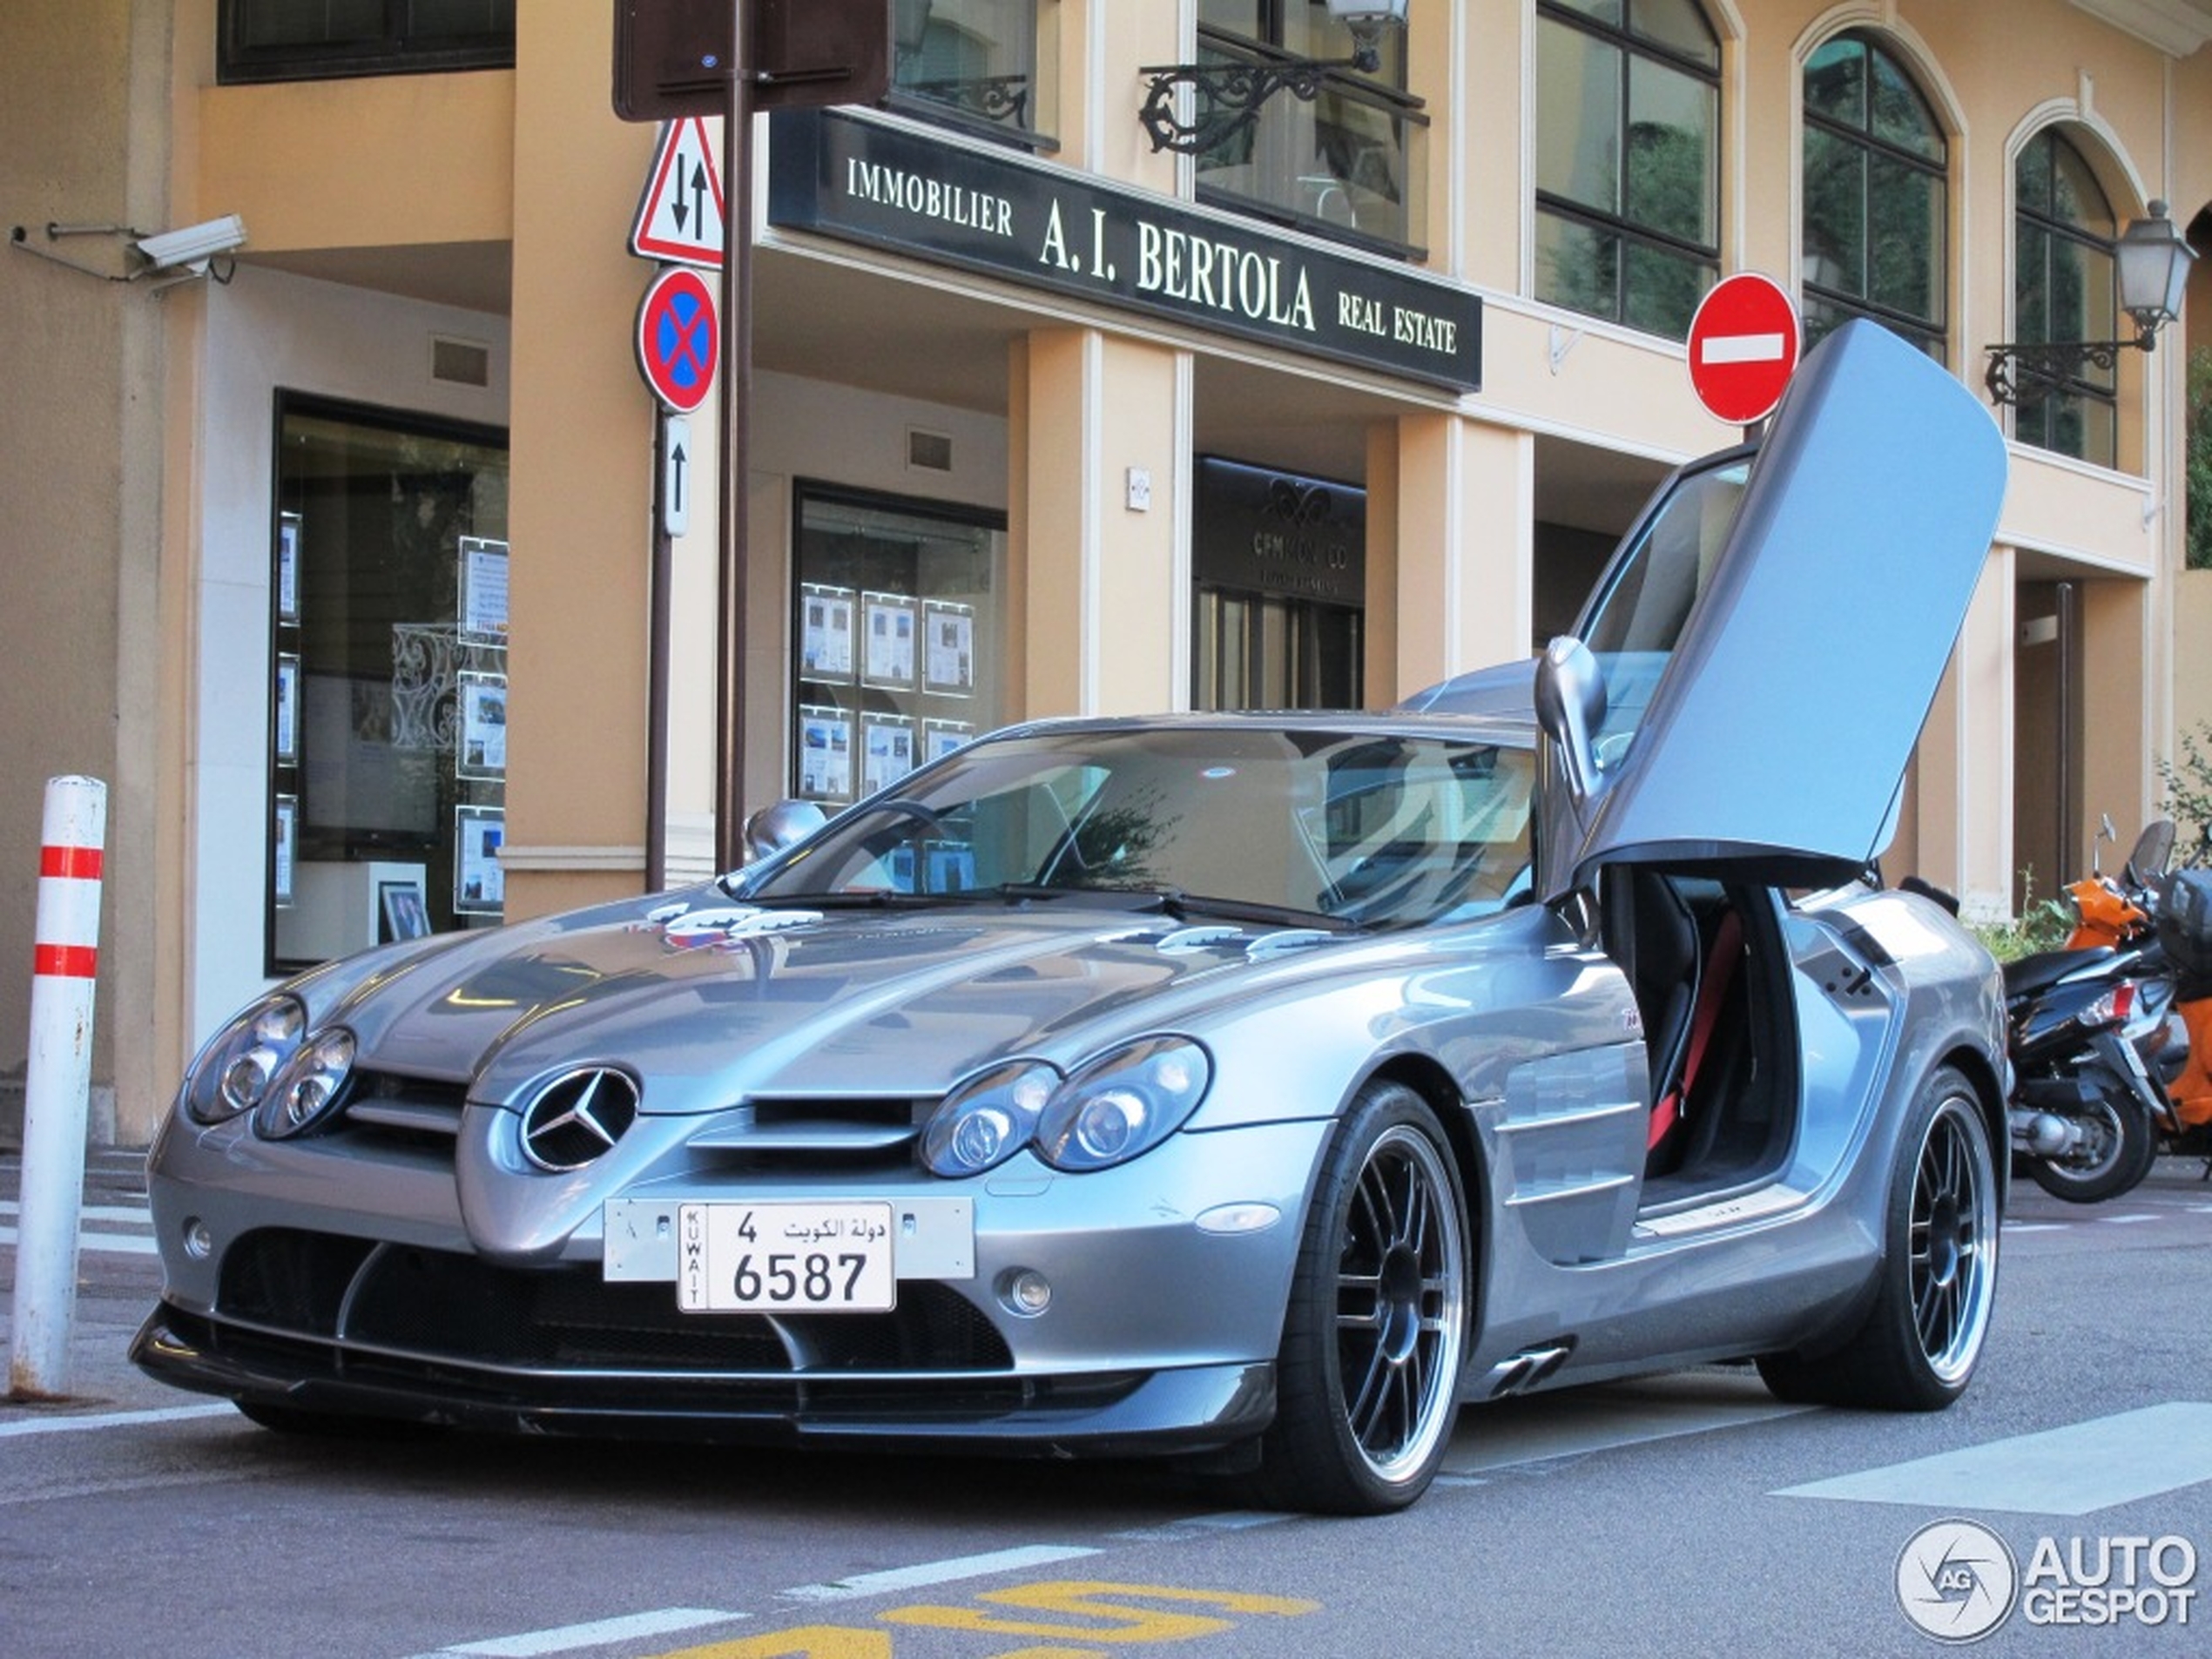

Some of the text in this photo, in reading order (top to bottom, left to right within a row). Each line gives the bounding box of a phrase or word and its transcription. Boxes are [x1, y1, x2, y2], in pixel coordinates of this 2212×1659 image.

[847, 158, 1013, 237] IMMOBILIER
[1137, 220, 1317, 332] BERTOLA
[1338, 291, 1458, 354] REAL ESTATE
[687, 1211, 700, 1303] KUWAIT
[738, 1211, 757, 1243] 4
[783, 1219, 886, 1243] دولة الكويت
[734, 1254, 867, 1301] 6587
